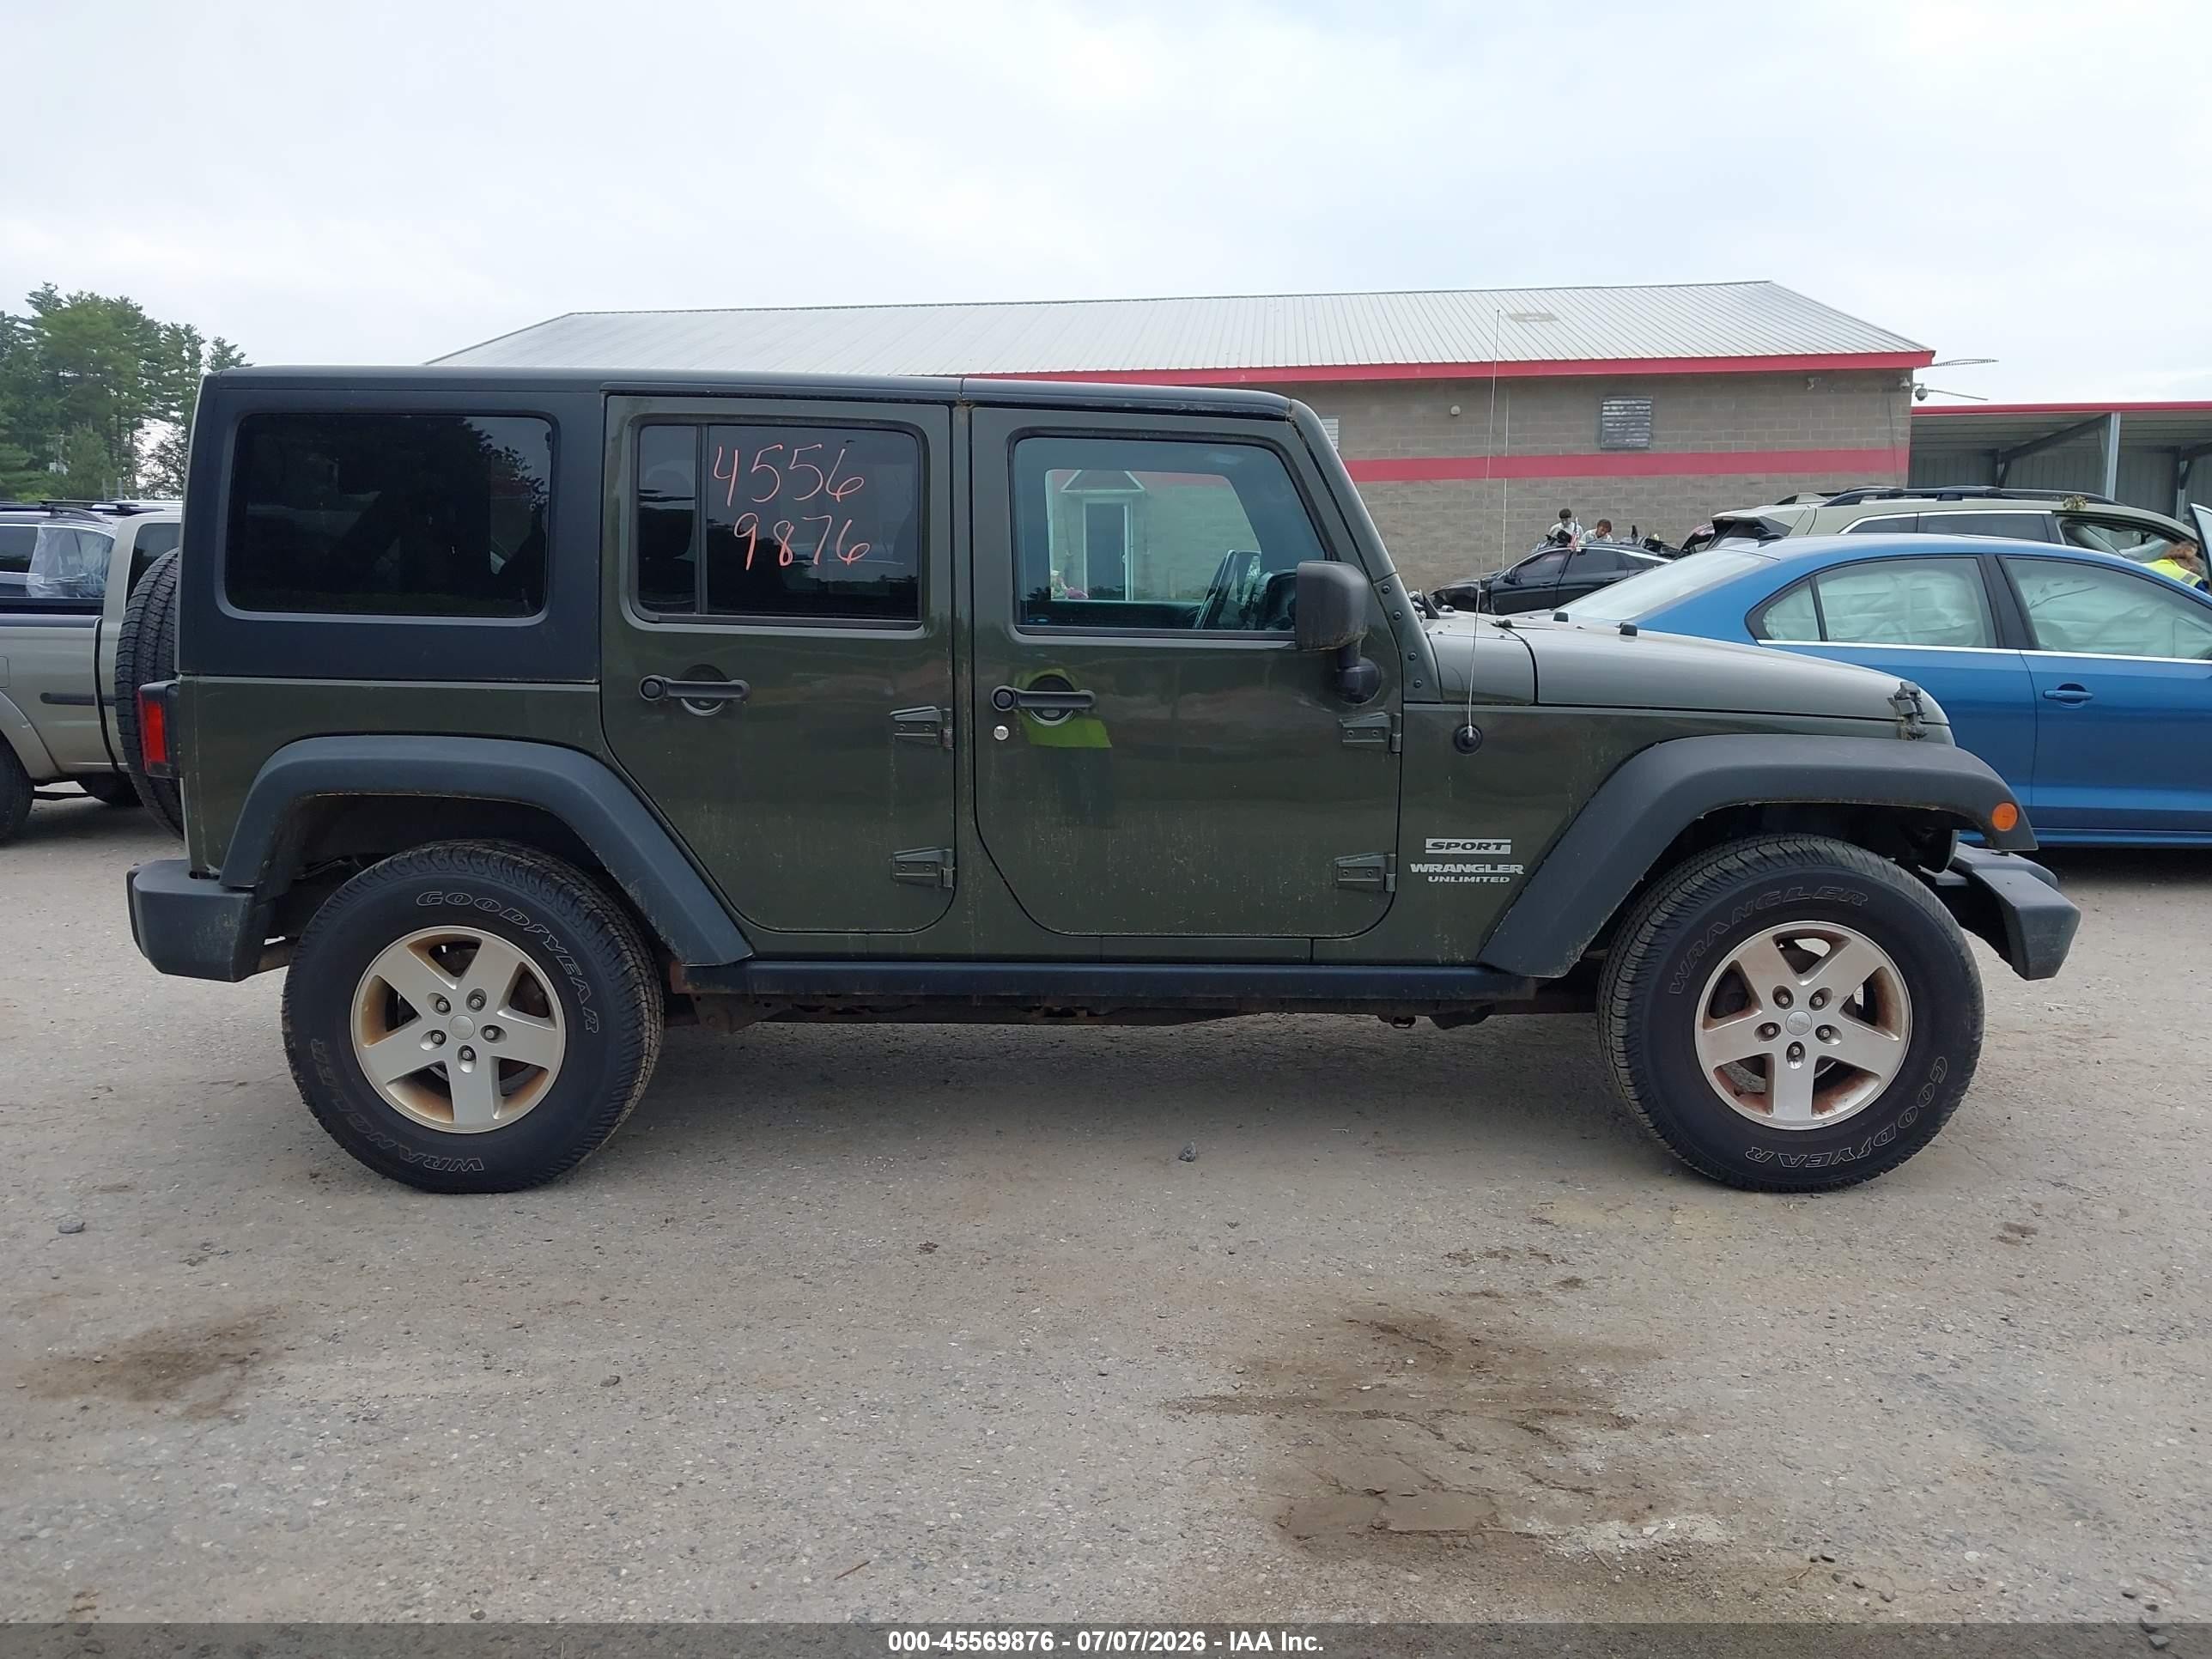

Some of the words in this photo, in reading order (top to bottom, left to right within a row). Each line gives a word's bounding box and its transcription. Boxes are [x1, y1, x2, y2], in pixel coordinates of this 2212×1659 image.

[713, 443, 866, 507] 4556
[733, 513, 871, 571] 9876
[1410, 863, 1525, 875] WRANGLER
[1429, 841, 1507, 851] SPORT
[416, 890, 599, 1034] GOODYEAR
[1669, 886, 1869, 995] WRANGLER
[1745, 1056, 1948, 1168] GOODYEAR
